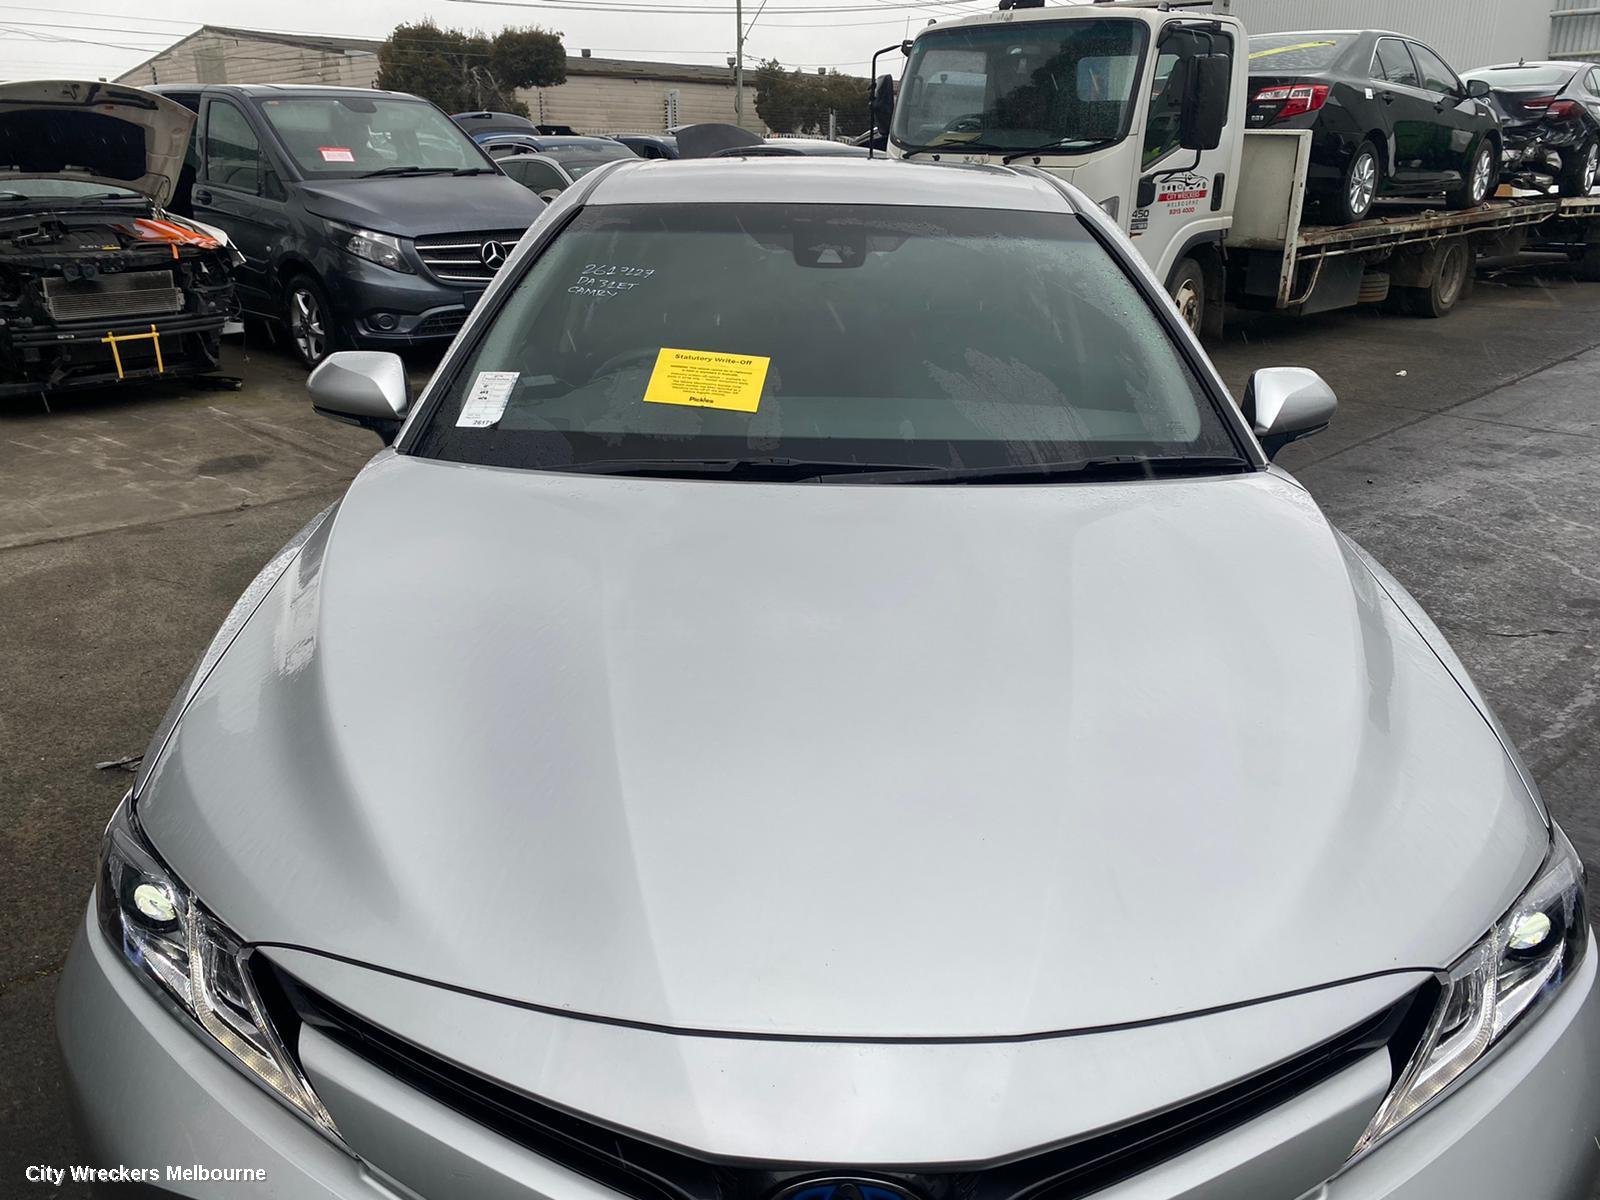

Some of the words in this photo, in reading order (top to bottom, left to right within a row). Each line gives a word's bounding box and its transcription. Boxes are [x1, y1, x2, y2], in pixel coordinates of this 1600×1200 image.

[1132, 209, 1150, 218] 450
[674, 353, 713, 363] Statutory
[714, 357, 753, 366] Write-Off
[688, 396, 714, 404] Pickles
